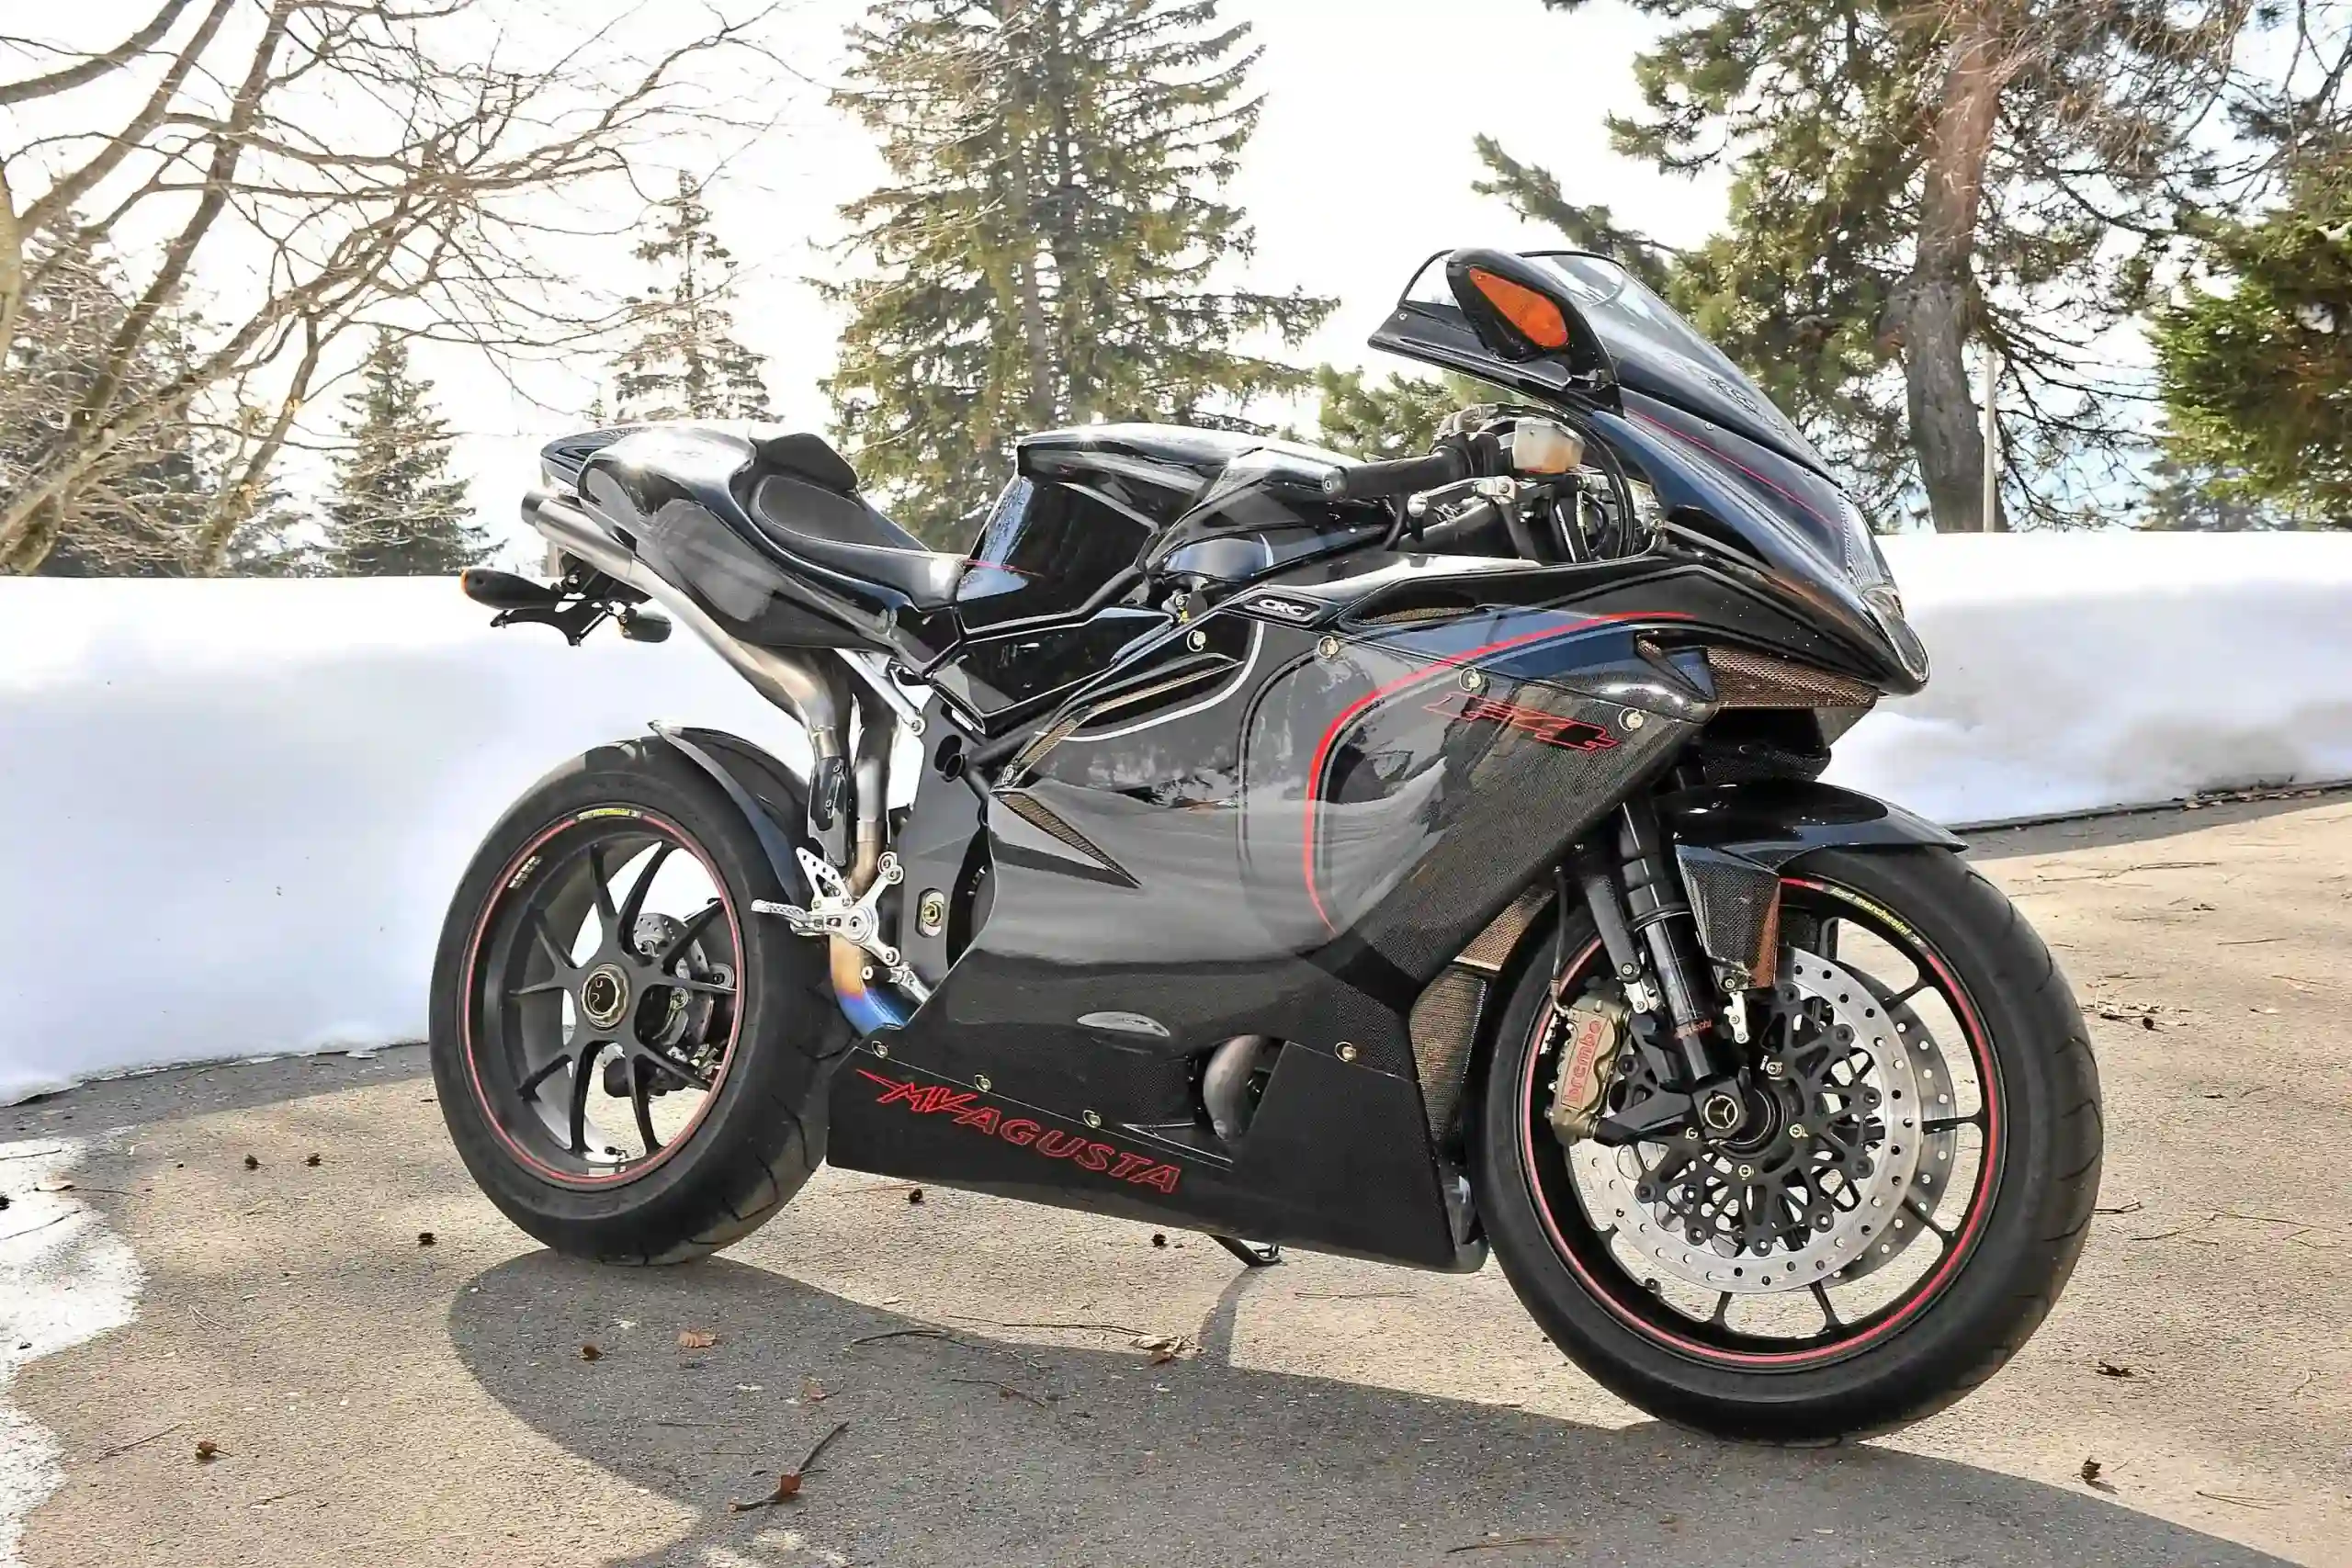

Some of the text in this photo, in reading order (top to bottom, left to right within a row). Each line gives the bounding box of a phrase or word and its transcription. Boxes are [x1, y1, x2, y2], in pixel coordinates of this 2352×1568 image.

[1259, 599, 1306, 616] CRC
[1563, 1020, 1602, 1103] brembo
[855, 1068, 1182, 1194] MV AGUSTA
